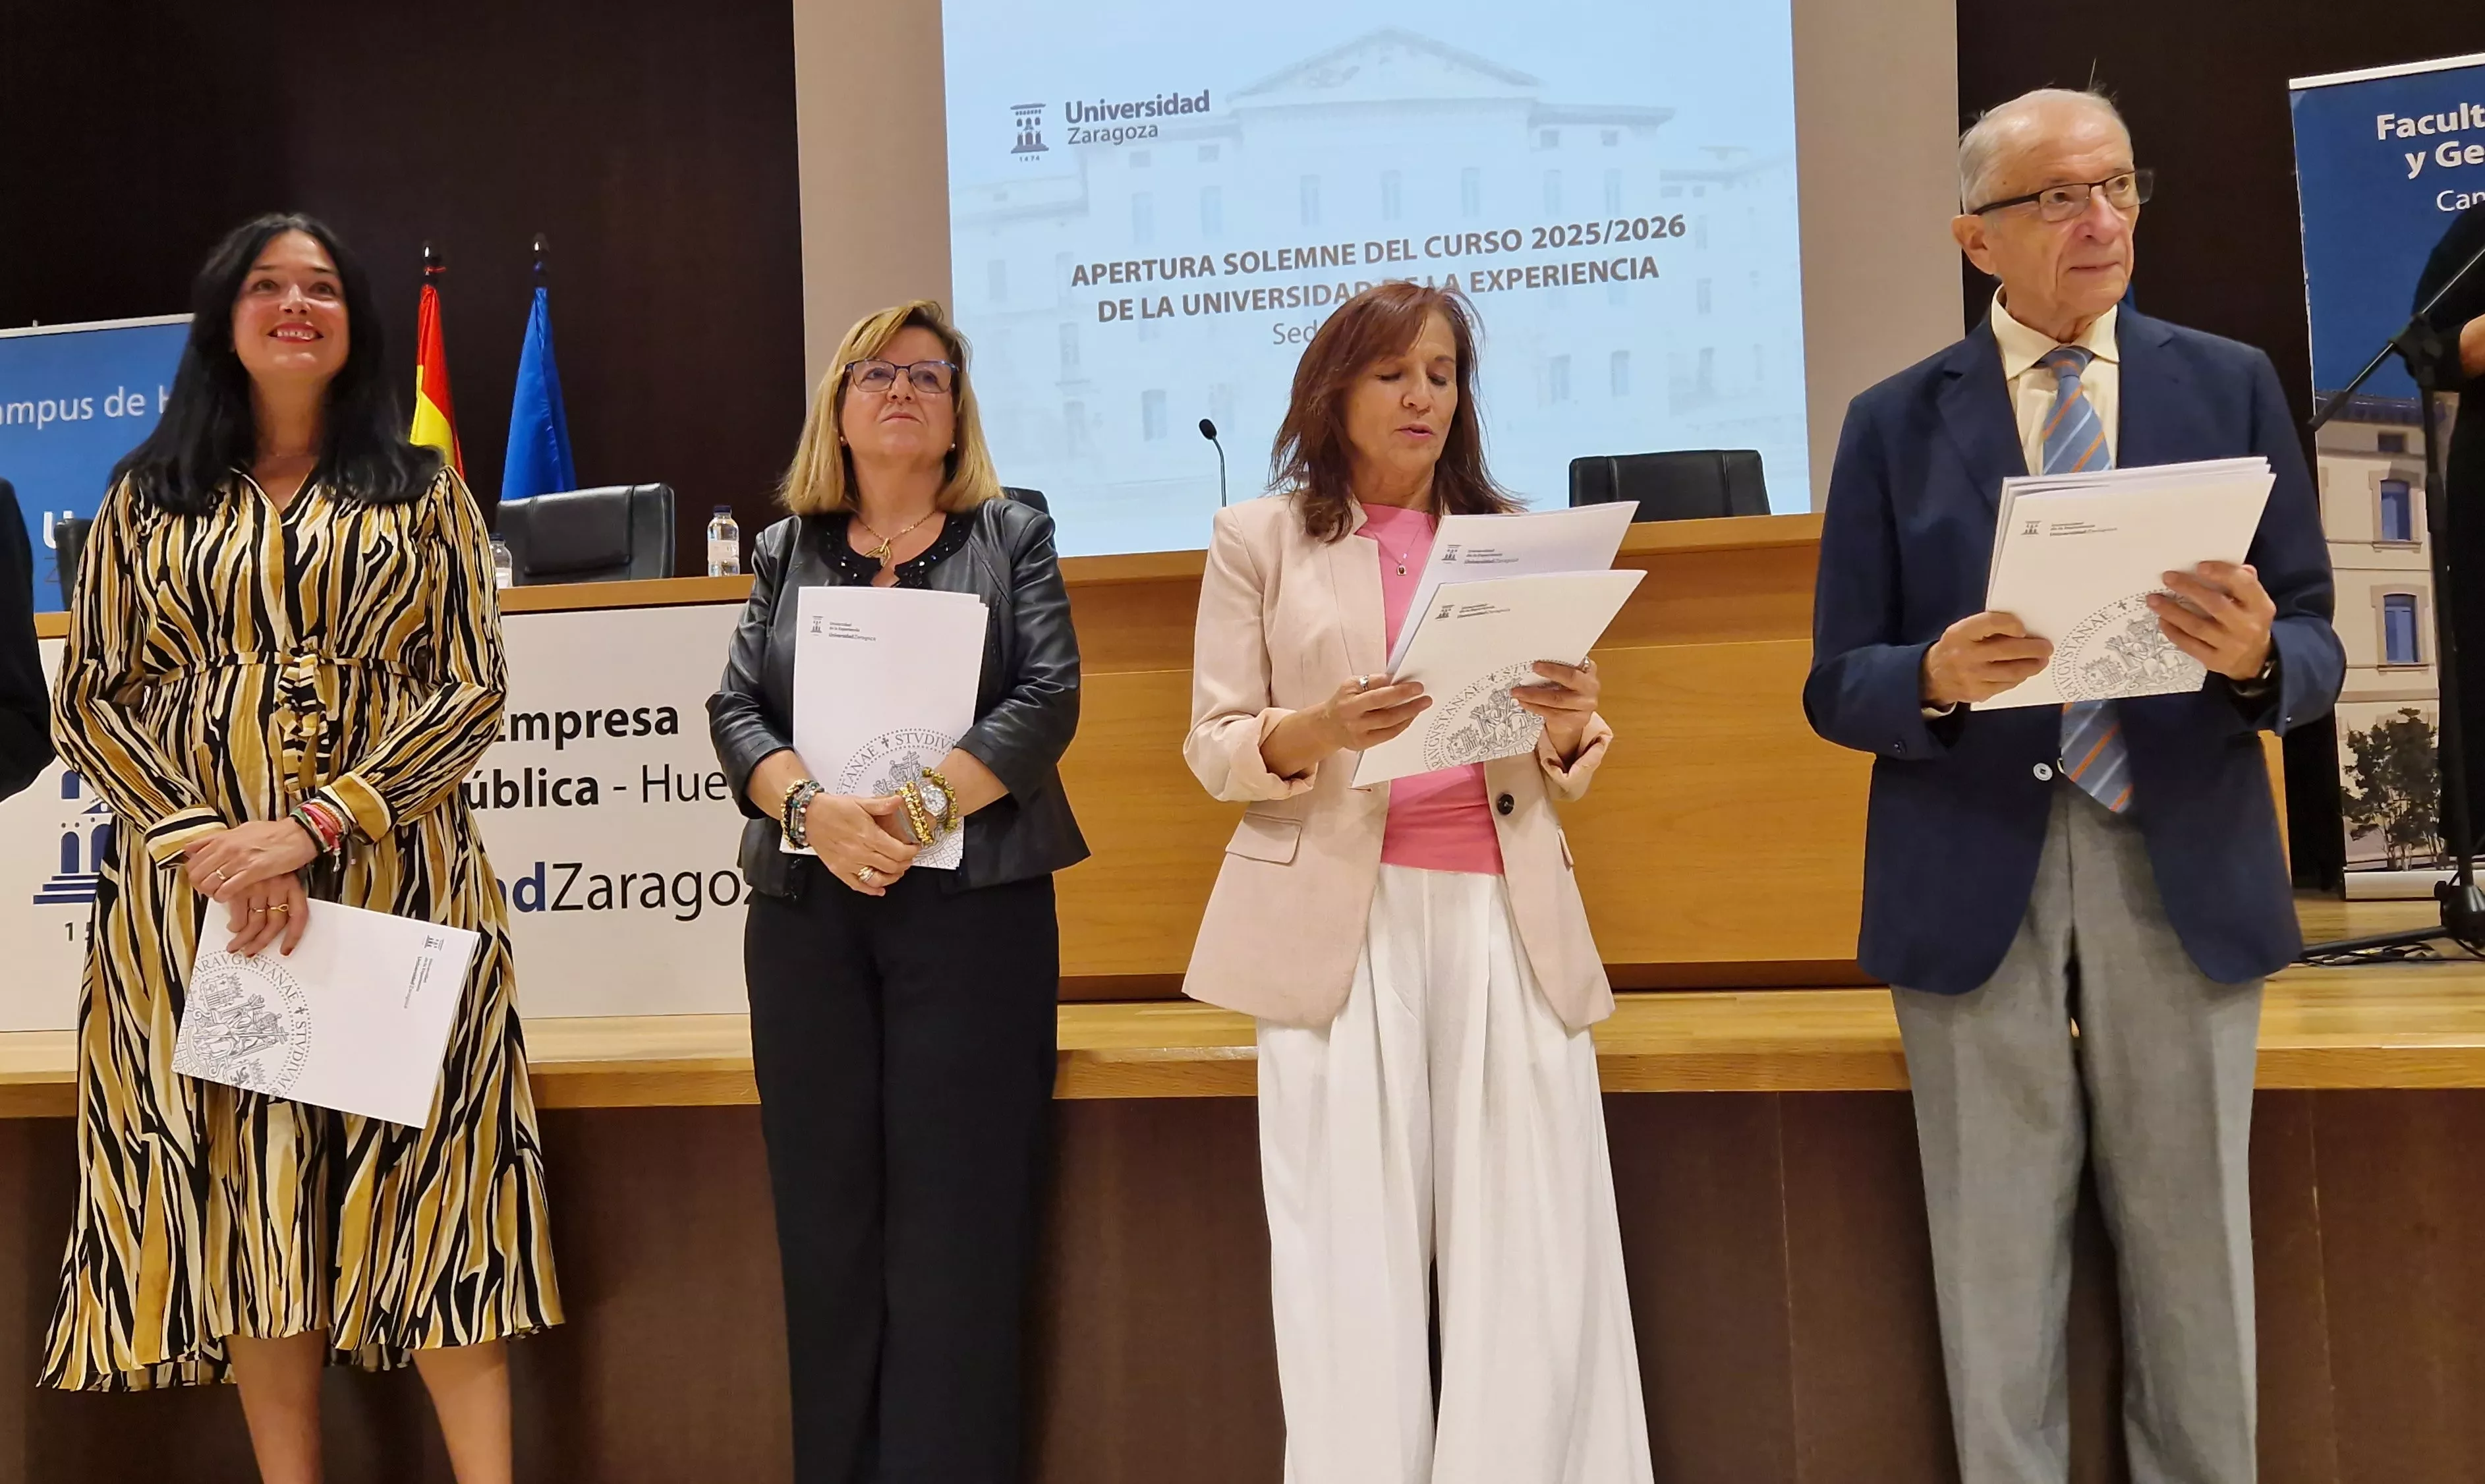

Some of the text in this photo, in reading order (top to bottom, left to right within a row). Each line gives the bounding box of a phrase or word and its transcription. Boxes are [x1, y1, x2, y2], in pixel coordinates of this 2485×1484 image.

[1065, 90, 1211, 123] Universidad
[2377, 103, 2485, 140] Facult
[1068, 125, 1158, 146] Zaragoza
[2405, 151, 2426, 179] y
[1071, 214, 1686, 287] APERTURA SOLEMNE DEL CURSO 2025/2026
[1098, 299, 1133, 322] DE
[1142, 296, 1175, 319] LA
[1470, 256, 1659, 293] EXPERIENCIA
[0, 397, 94, 430] mpus
[104, 385, 146, 417] de
